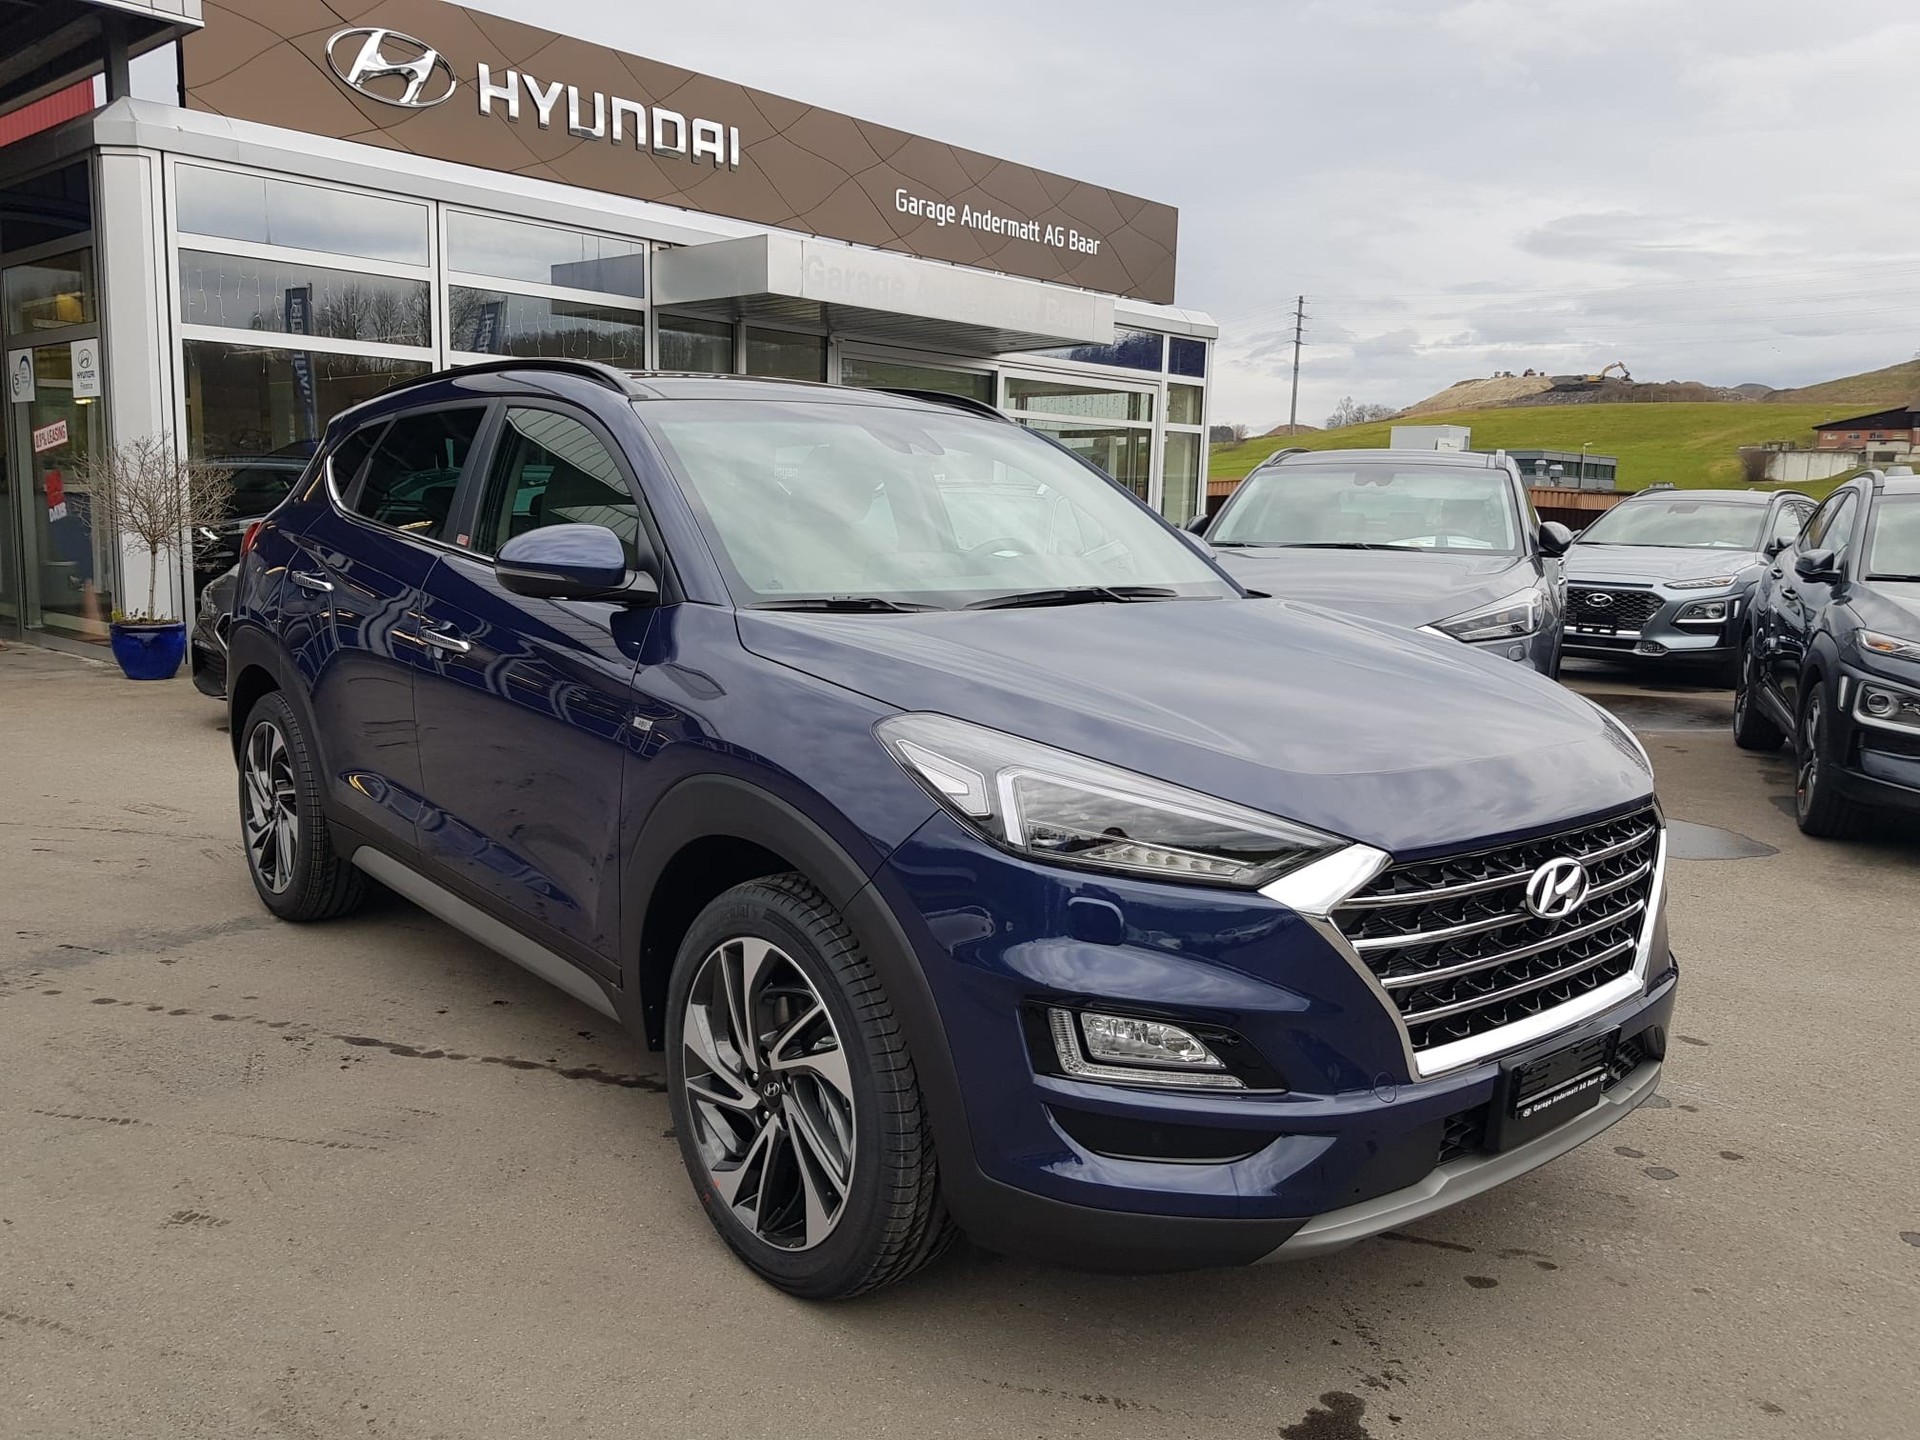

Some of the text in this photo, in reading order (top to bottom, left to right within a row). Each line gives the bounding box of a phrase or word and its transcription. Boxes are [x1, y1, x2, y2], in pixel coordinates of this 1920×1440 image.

[477, 62, 740, 172] HYUNDAI
[895, 188, 1101, 255] Garage Andermatt AG Baar
[76, 370, 96, 380] HYUNDAI
[47, 424, 66, 444] LEASING
[1533, 1100, 1552, 1111] Garage
[1553, 1087, 1579, 1102] Andermatt
[1579, 1082, 1587, 1091] AG
